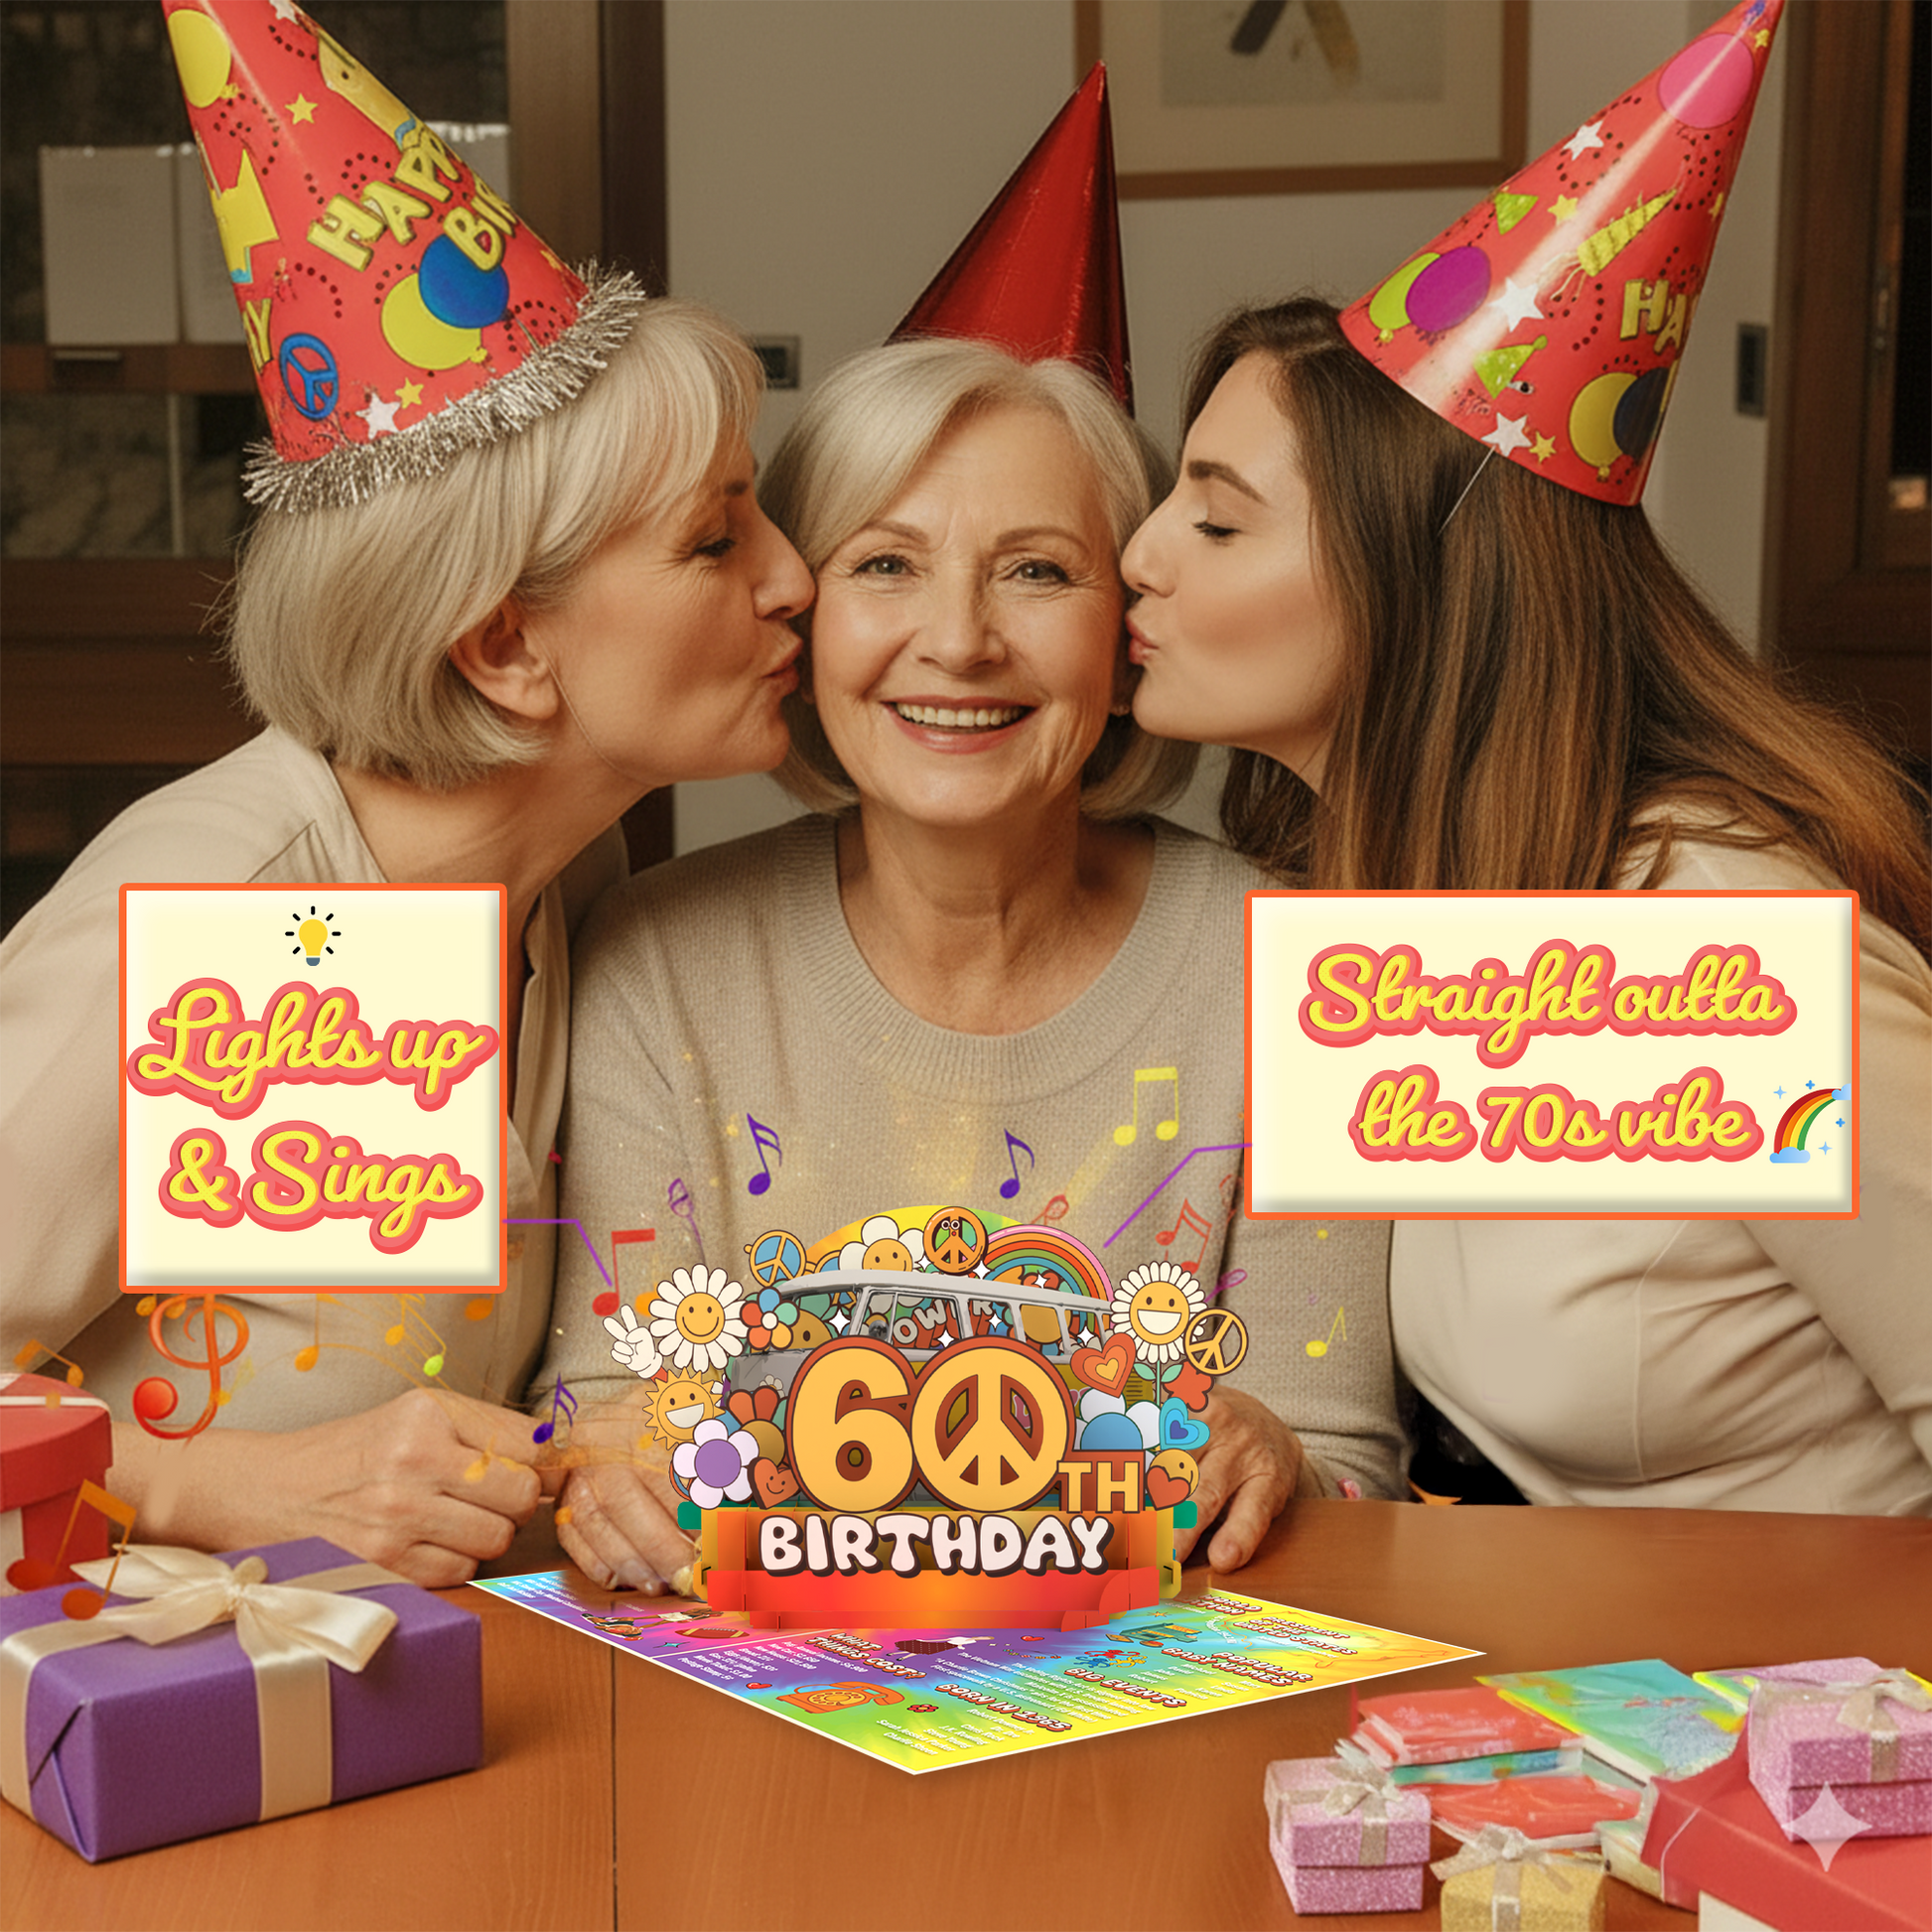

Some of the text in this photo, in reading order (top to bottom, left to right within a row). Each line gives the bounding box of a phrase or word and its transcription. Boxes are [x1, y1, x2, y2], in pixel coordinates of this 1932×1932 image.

[759, 1514, 1114, 1577] BIRTHDAY
[1198, 1594, 1262, 1612] WORLD
[1232, 1621, 1291, 1639] UNITED
[1288, 1635, 1357, 1655] STATES
[1261, 1616, 1351, 1639] PRESIDENT
[1272, 1624, 1308, 1636] THE
[827, 1632, 883, 1652] WHAT
[804, 1636, 926, 1680] THINGS COST?
[942, 1661, 969, 1671] Charlie
[964, 1669, 991, 1679] Brown
[1161, 1648, 1293, 1687] BABY NAMES
[1211, 1652, 1312, 1682] POPULAR
[971, 1656, 1001, 1667] Vietnam
[1082, 1693, 1110, 1703] troops
[1108, 1701, 1143, 1714] landing
[1025, 1667, 1050, 1677] Voting
[1048, 1675, 1074, 1684] Rights
[1094, 1690, 1125, 1700] signed
[1062, 1667, 1186, 1708] BIG EVENTS
[934, 1683, 1071, 1731] BORN IN 1965
[966, 1709, 998, 1721] Robert
[993, 1719, 1027, 1730] Downey
[876, 1720, 956, 1751] Sarah Jessica Parker
[884, 1732, 938, 1755] Charlie Sheen
[923, 1728, 974, 1748] Steve Young
[954, 1730, 990, 1745] Rowling
[960, 1724, 1005, 1741] Chris Rock
